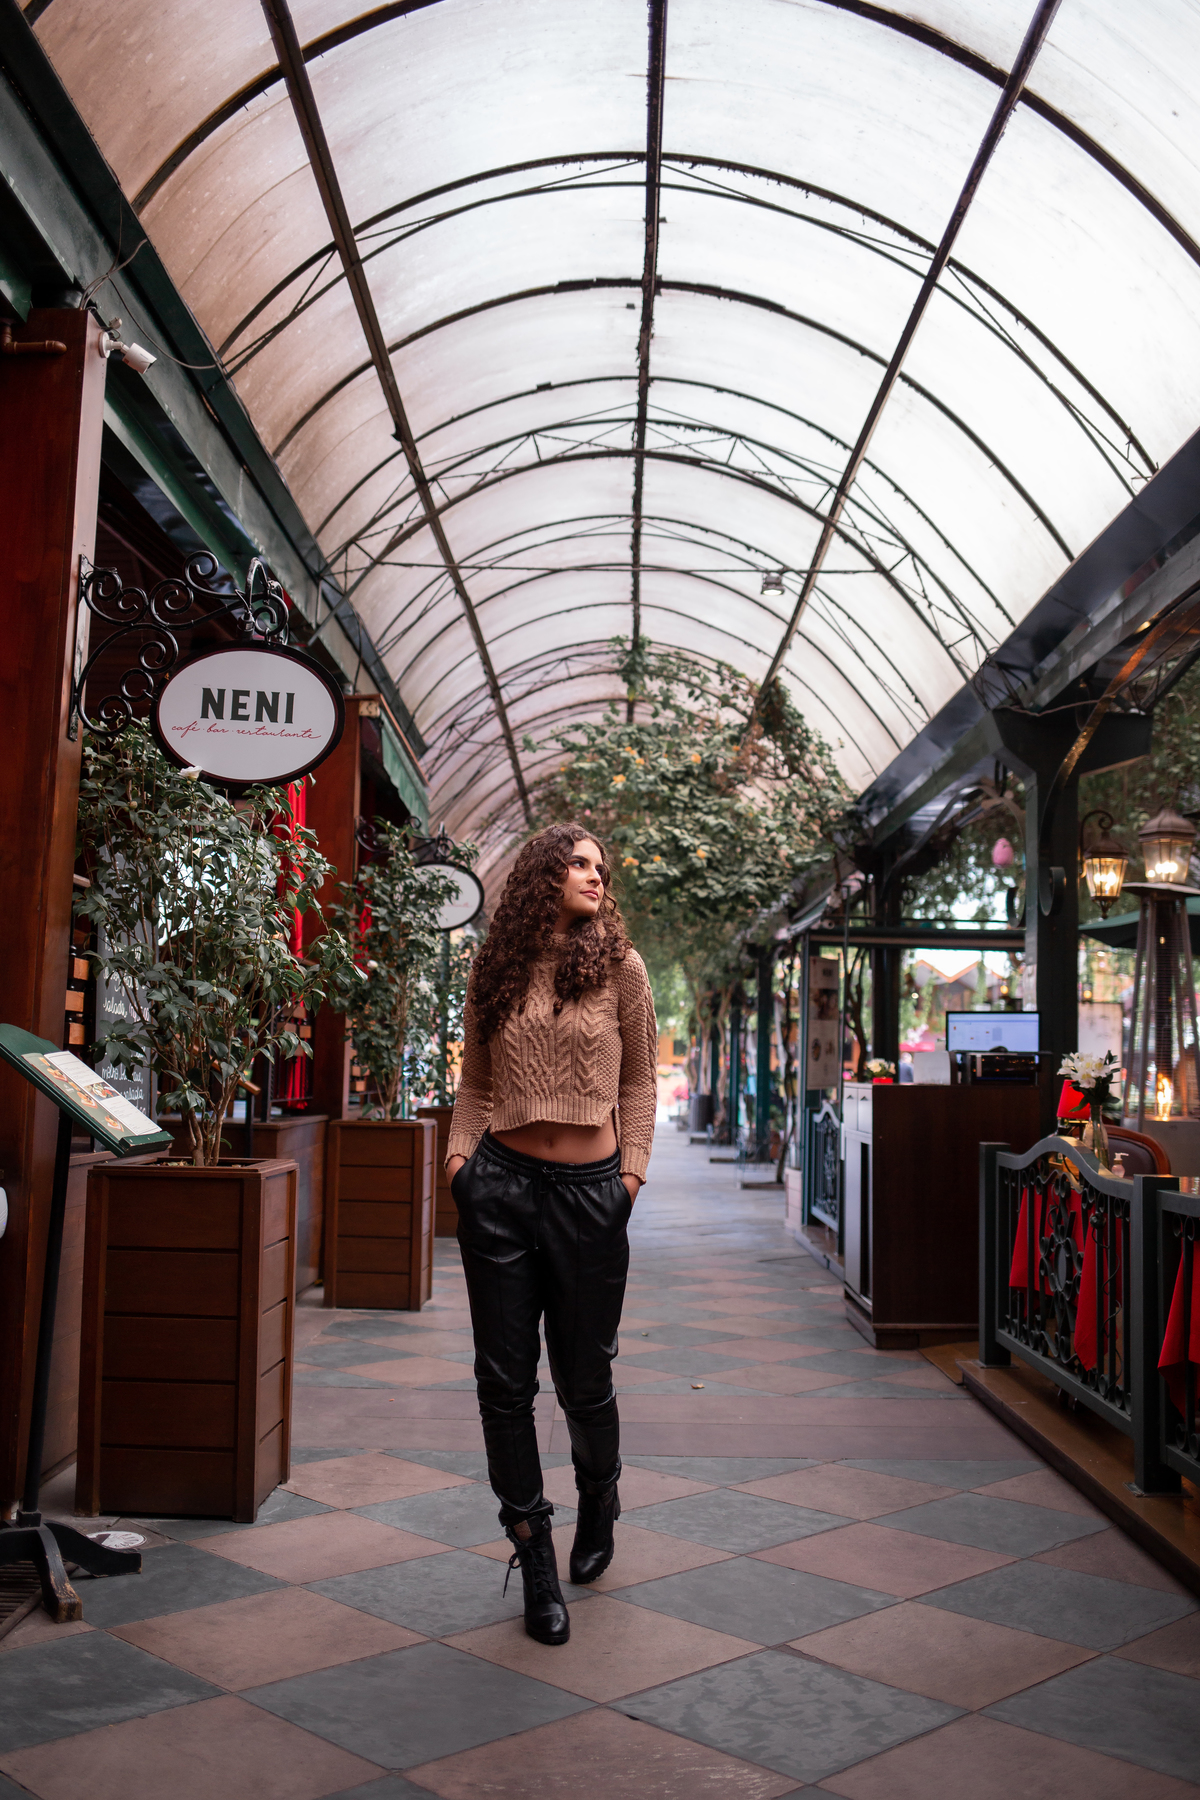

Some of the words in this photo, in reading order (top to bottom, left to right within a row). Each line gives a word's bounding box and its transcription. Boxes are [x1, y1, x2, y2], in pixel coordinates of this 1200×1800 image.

[200, 687, 296, 724] NENI
[171, 720, 200, 739] café
[206, 722, 230, 734] bar
[236, 725, 322, 740] restaurante
